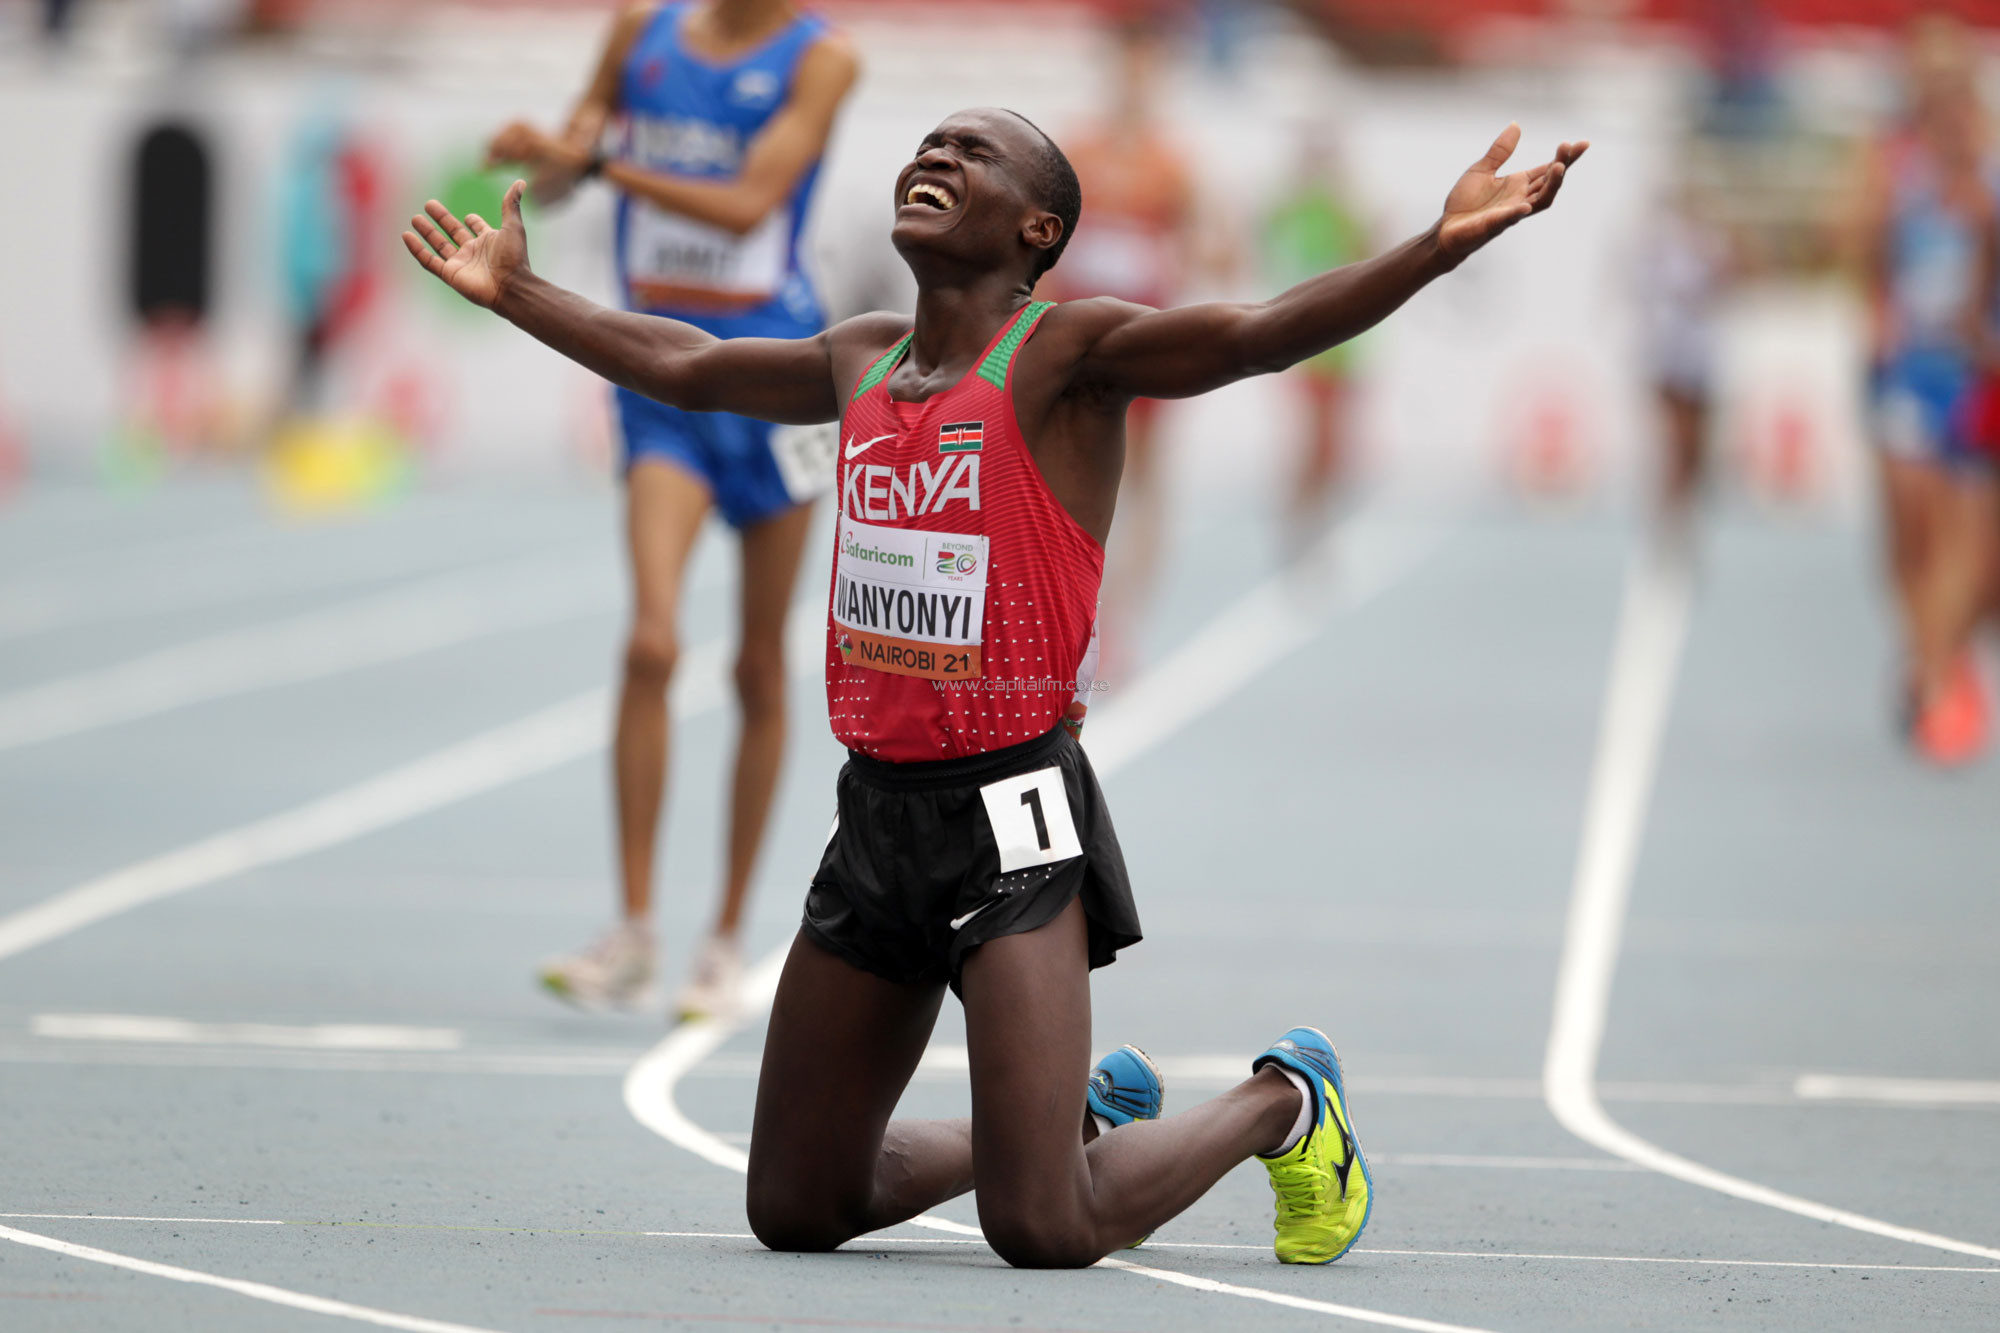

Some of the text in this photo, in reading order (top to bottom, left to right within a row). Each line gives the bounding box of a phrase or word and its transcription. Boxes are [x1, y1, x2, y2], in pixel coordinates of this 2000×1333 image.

[843, 454, 981, 520] KENYA
[843, 535, 914, 567] Safaricom
[942, 542, 974, 551] BEYOND
[837, 573, 972, 639] WANYONYI
[860, 641, 968, 673] NAIROBI 21
[1021, 787, 1051, 851] 1
